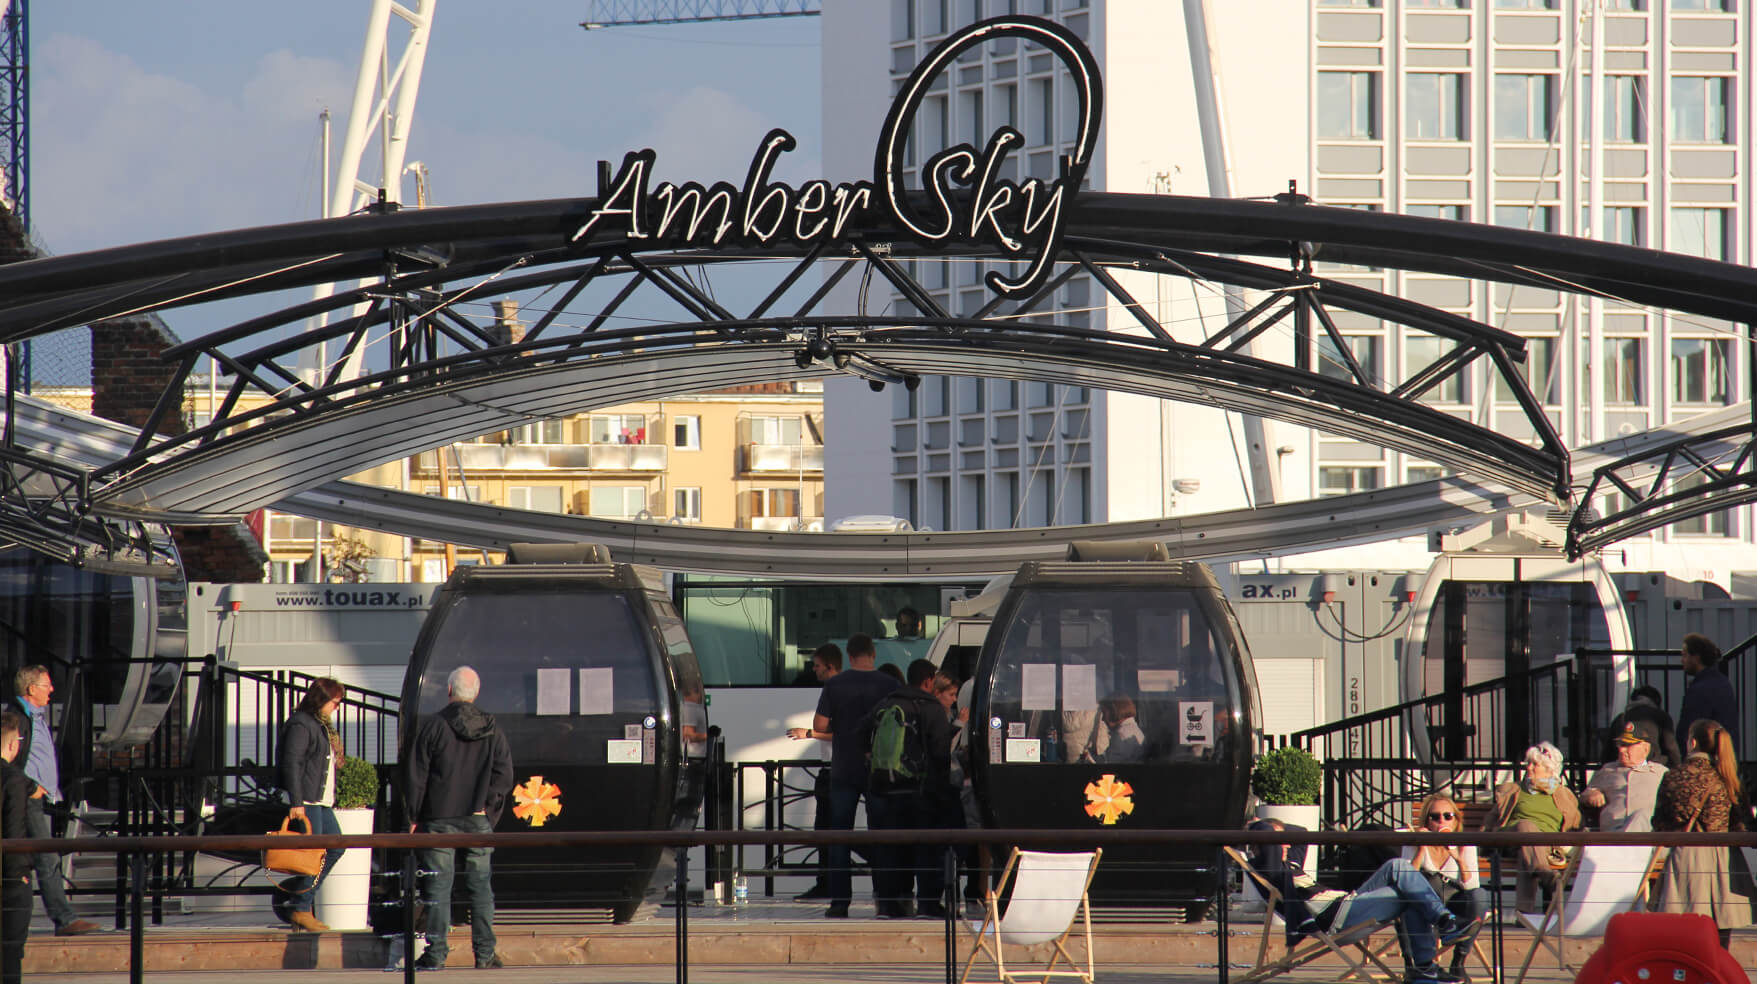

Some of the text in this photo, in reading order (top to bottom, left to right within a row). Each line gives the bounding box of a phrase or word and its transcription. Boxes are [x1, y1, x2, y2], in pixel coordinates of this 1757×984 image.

[566, 15, 1102, 299] Amber Sky
[276, 589, 423, 608] www.touax.pl
